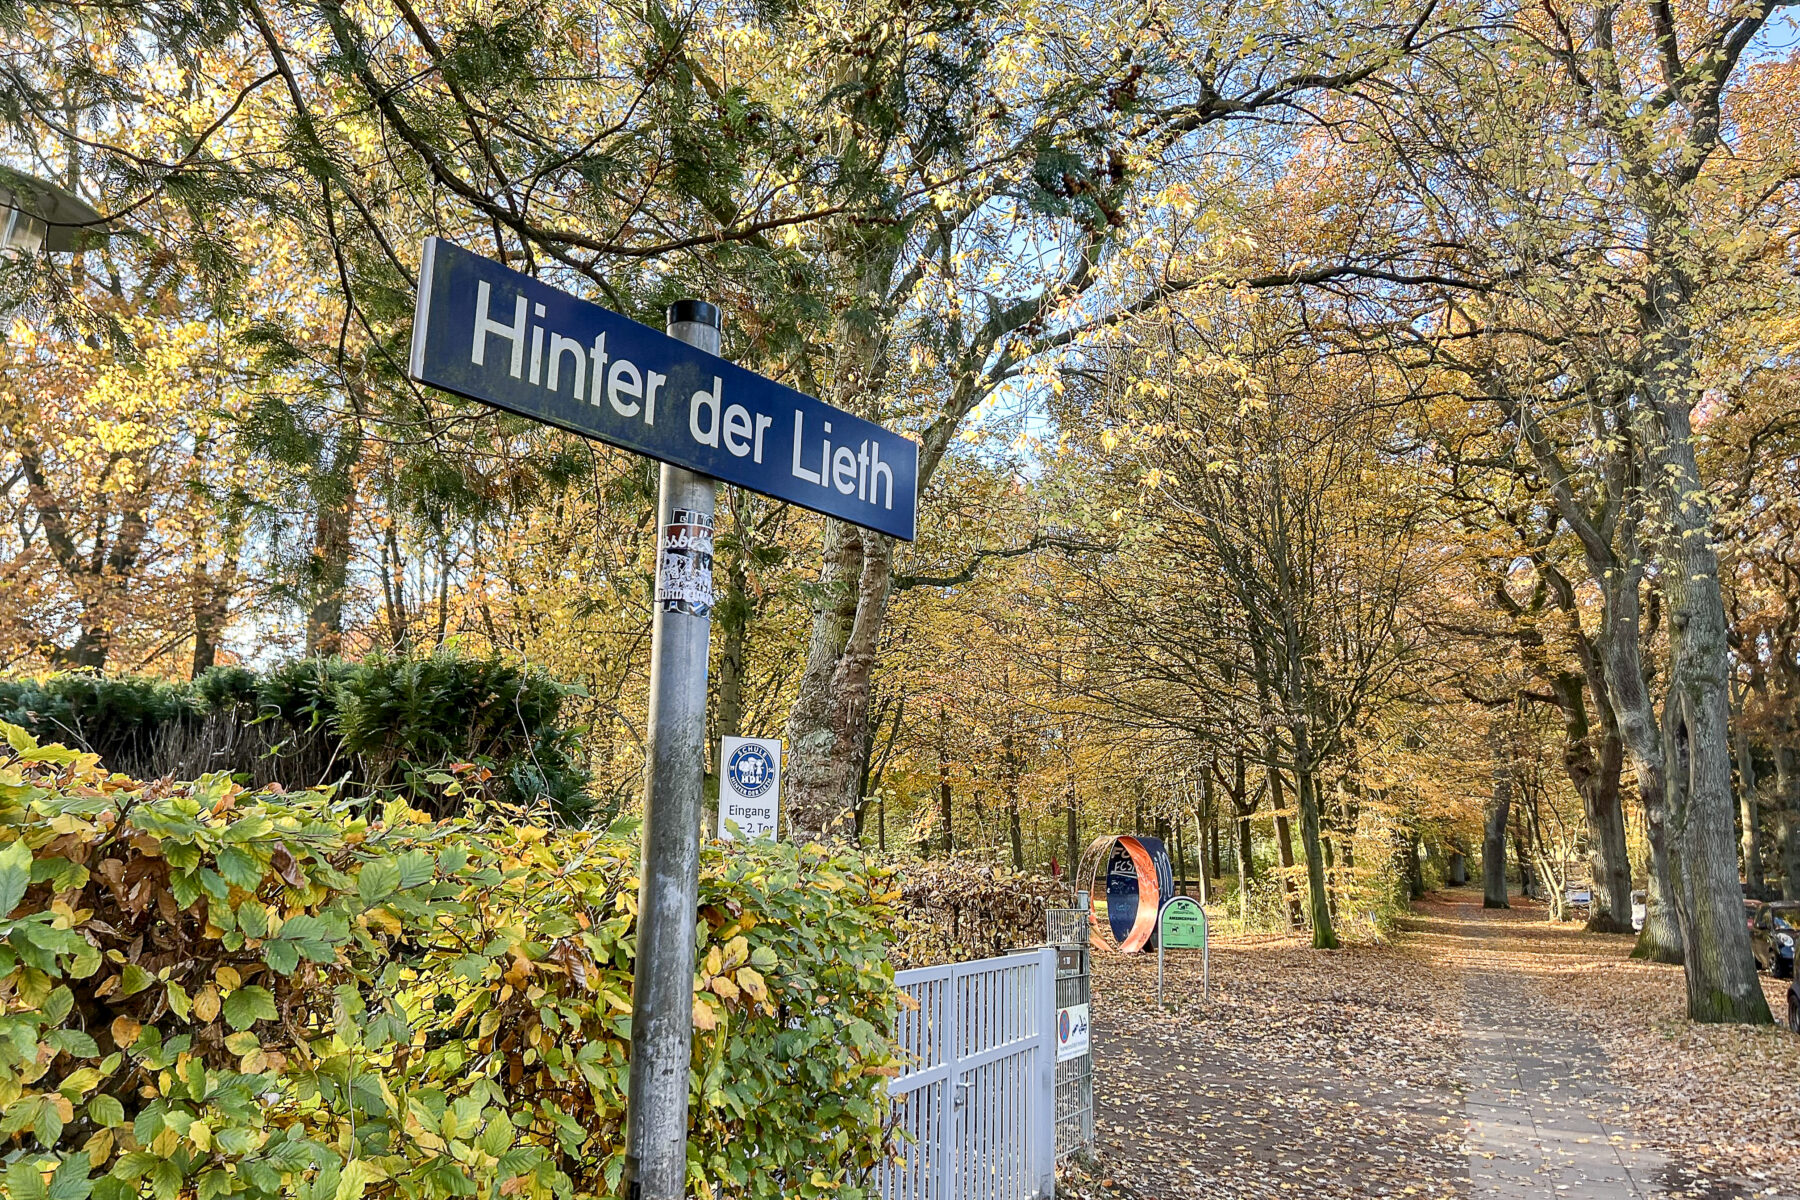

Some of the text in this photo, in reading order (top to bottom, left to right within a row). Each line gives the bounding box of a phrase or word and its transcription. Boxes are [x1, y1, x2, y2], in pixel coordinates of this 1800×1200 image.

[471, 280, 894, 510] Hinter der Lieth
[737, 745, 767, 757] SCHULE
[741, 775, 762, 784] HDL
[729, 805, 770, 819] Eingang
[747, 823, 774, 833] 2. Tor
